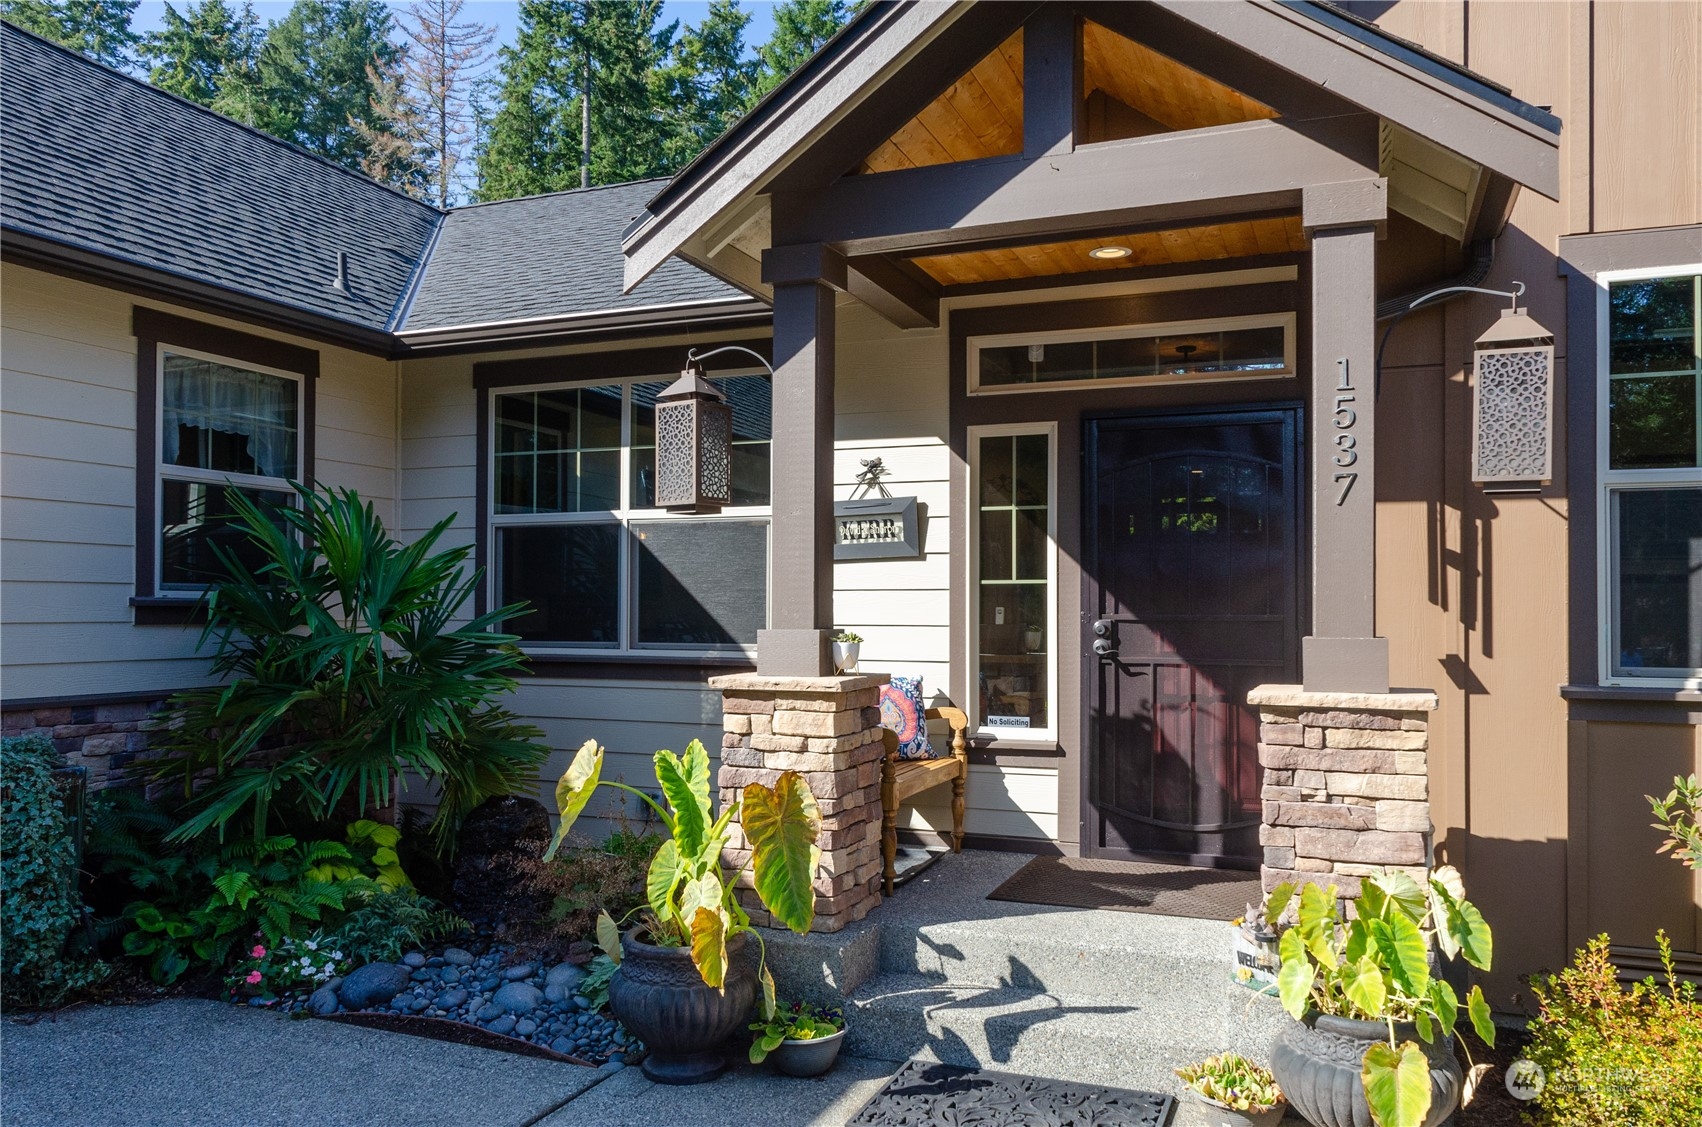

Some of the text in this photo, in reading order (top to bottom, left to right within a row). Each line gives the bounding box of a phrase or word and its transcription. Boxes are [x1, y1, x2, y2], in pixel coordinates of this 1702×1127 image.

[1332, 357, 1358, 506] 1537
[841, 519, 896, 540] KERR
[999, 718, 1028, 727] Soliciting
